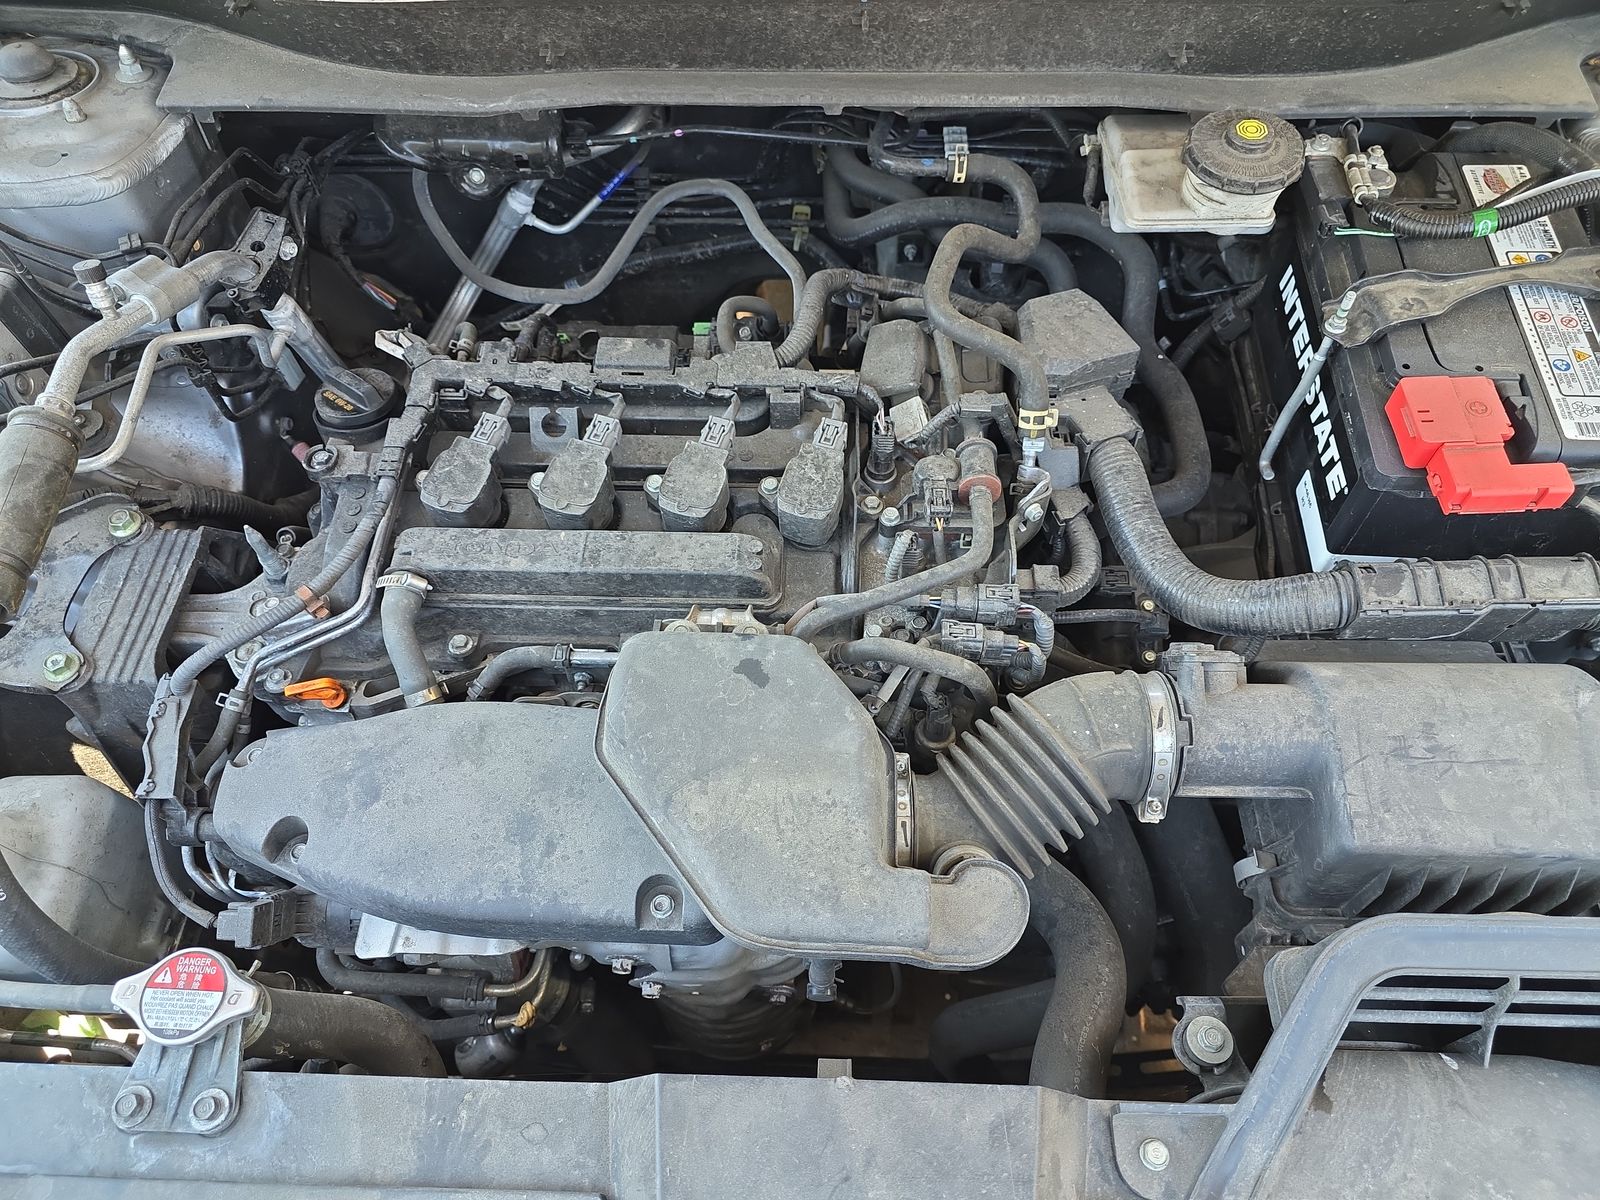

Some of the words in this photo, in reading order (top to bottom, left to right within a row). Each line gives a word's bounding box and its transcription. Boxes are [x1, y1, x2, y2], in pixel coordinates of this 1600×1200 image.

[322, 390, 338, 401] SAE
[334, 397, 354, 412] 0W-20
[178, 957, 212, 966] DANGER
[176, 964, 217, 975] WARNUNG
